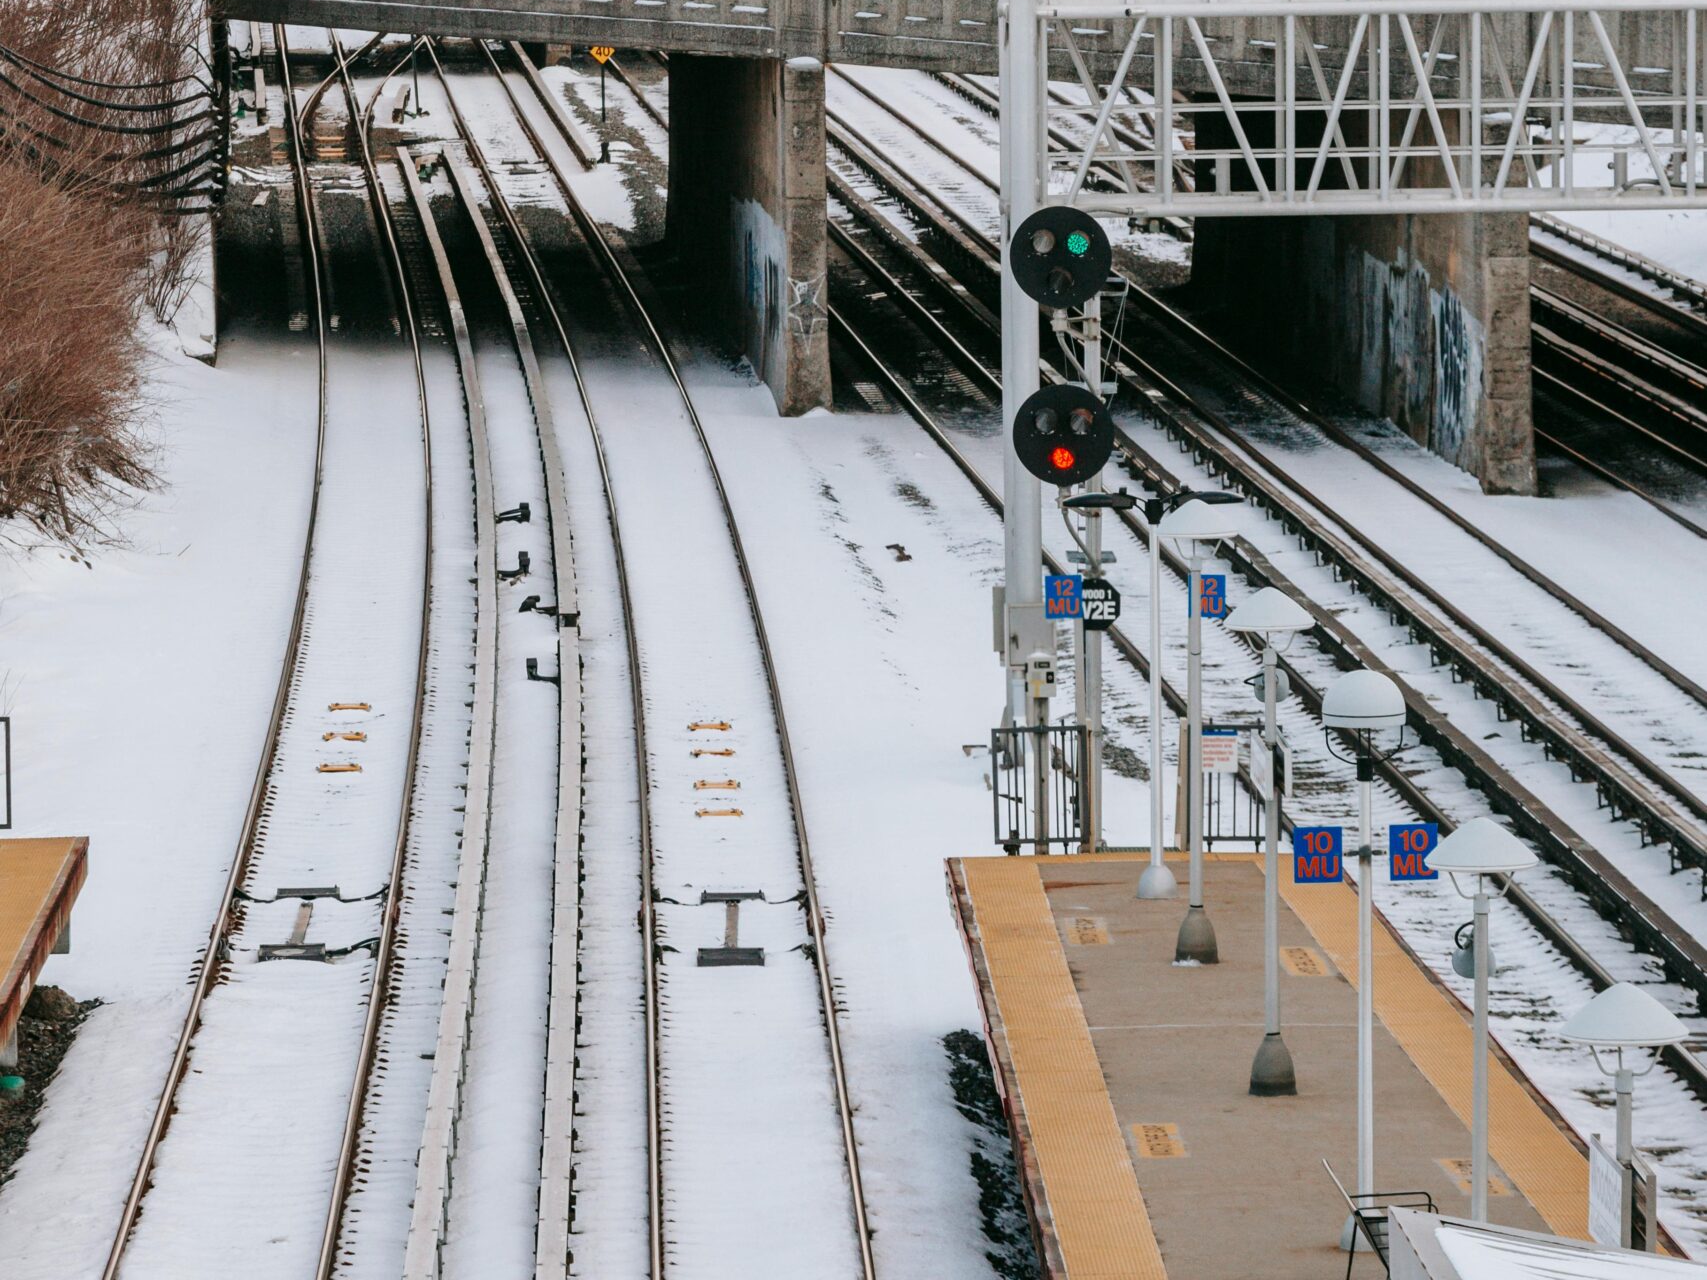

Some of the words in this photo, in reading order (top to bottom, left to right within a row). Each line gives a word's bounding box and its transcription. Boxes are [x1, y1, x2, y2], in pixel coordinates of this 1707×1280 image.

[595, 46, 610, 57] 40
[1055, 578, 1074, 596] 12
[1106, 589, 1112, 600] 1
[1200, 577, 1217, 595] 12
[1048, 598, 1080, 615] MU
[1303, 831, 1334, 854] 10
[1399, 829, 1429, 852] 10
[1297, 856, 1340, 878] MU
[1393, 854, 1434, 876] MU
